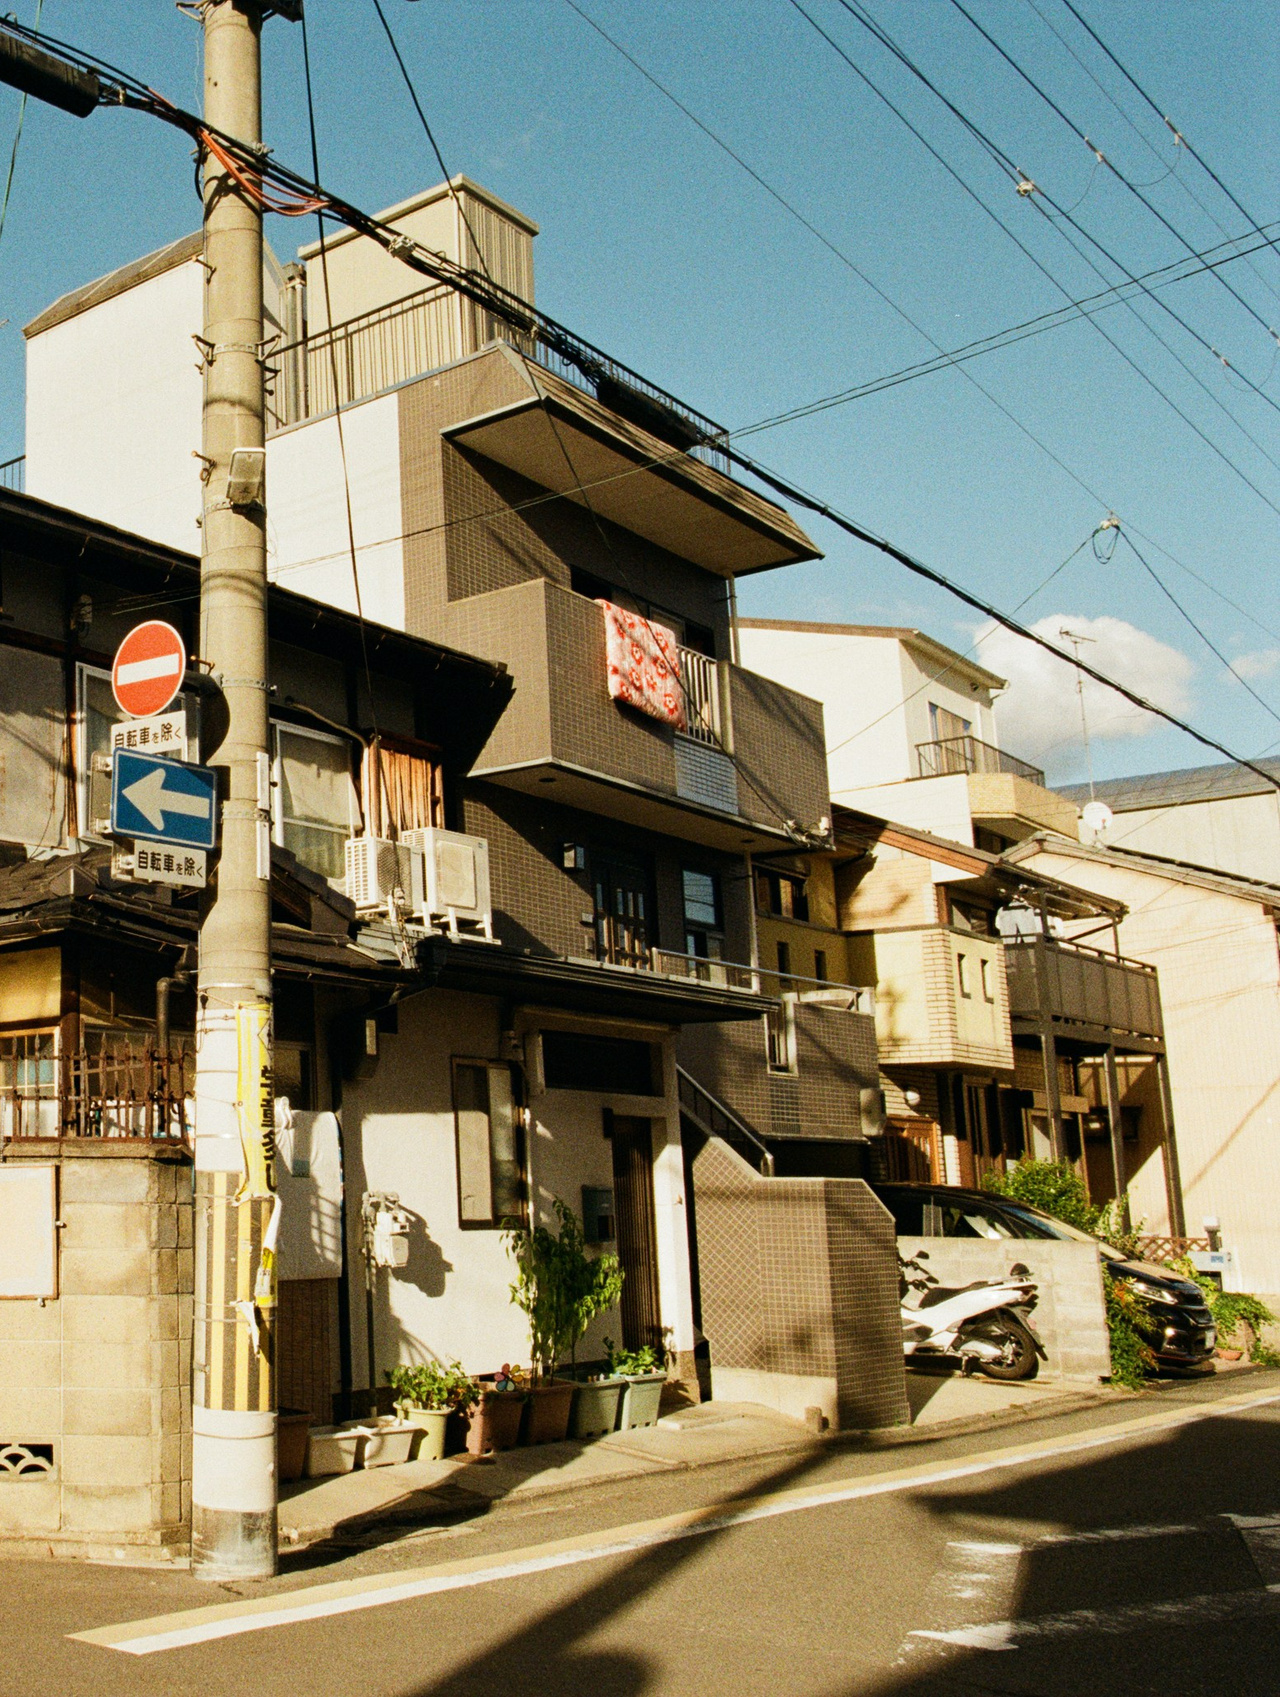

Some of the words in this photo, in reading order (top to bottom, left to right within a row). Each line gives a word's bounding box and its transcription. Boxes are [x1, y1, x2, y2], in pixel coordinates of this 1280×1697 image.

[114, 722, 181, 748] 自転車を除く
[138, 850, 203, 878] 自転車を除く
